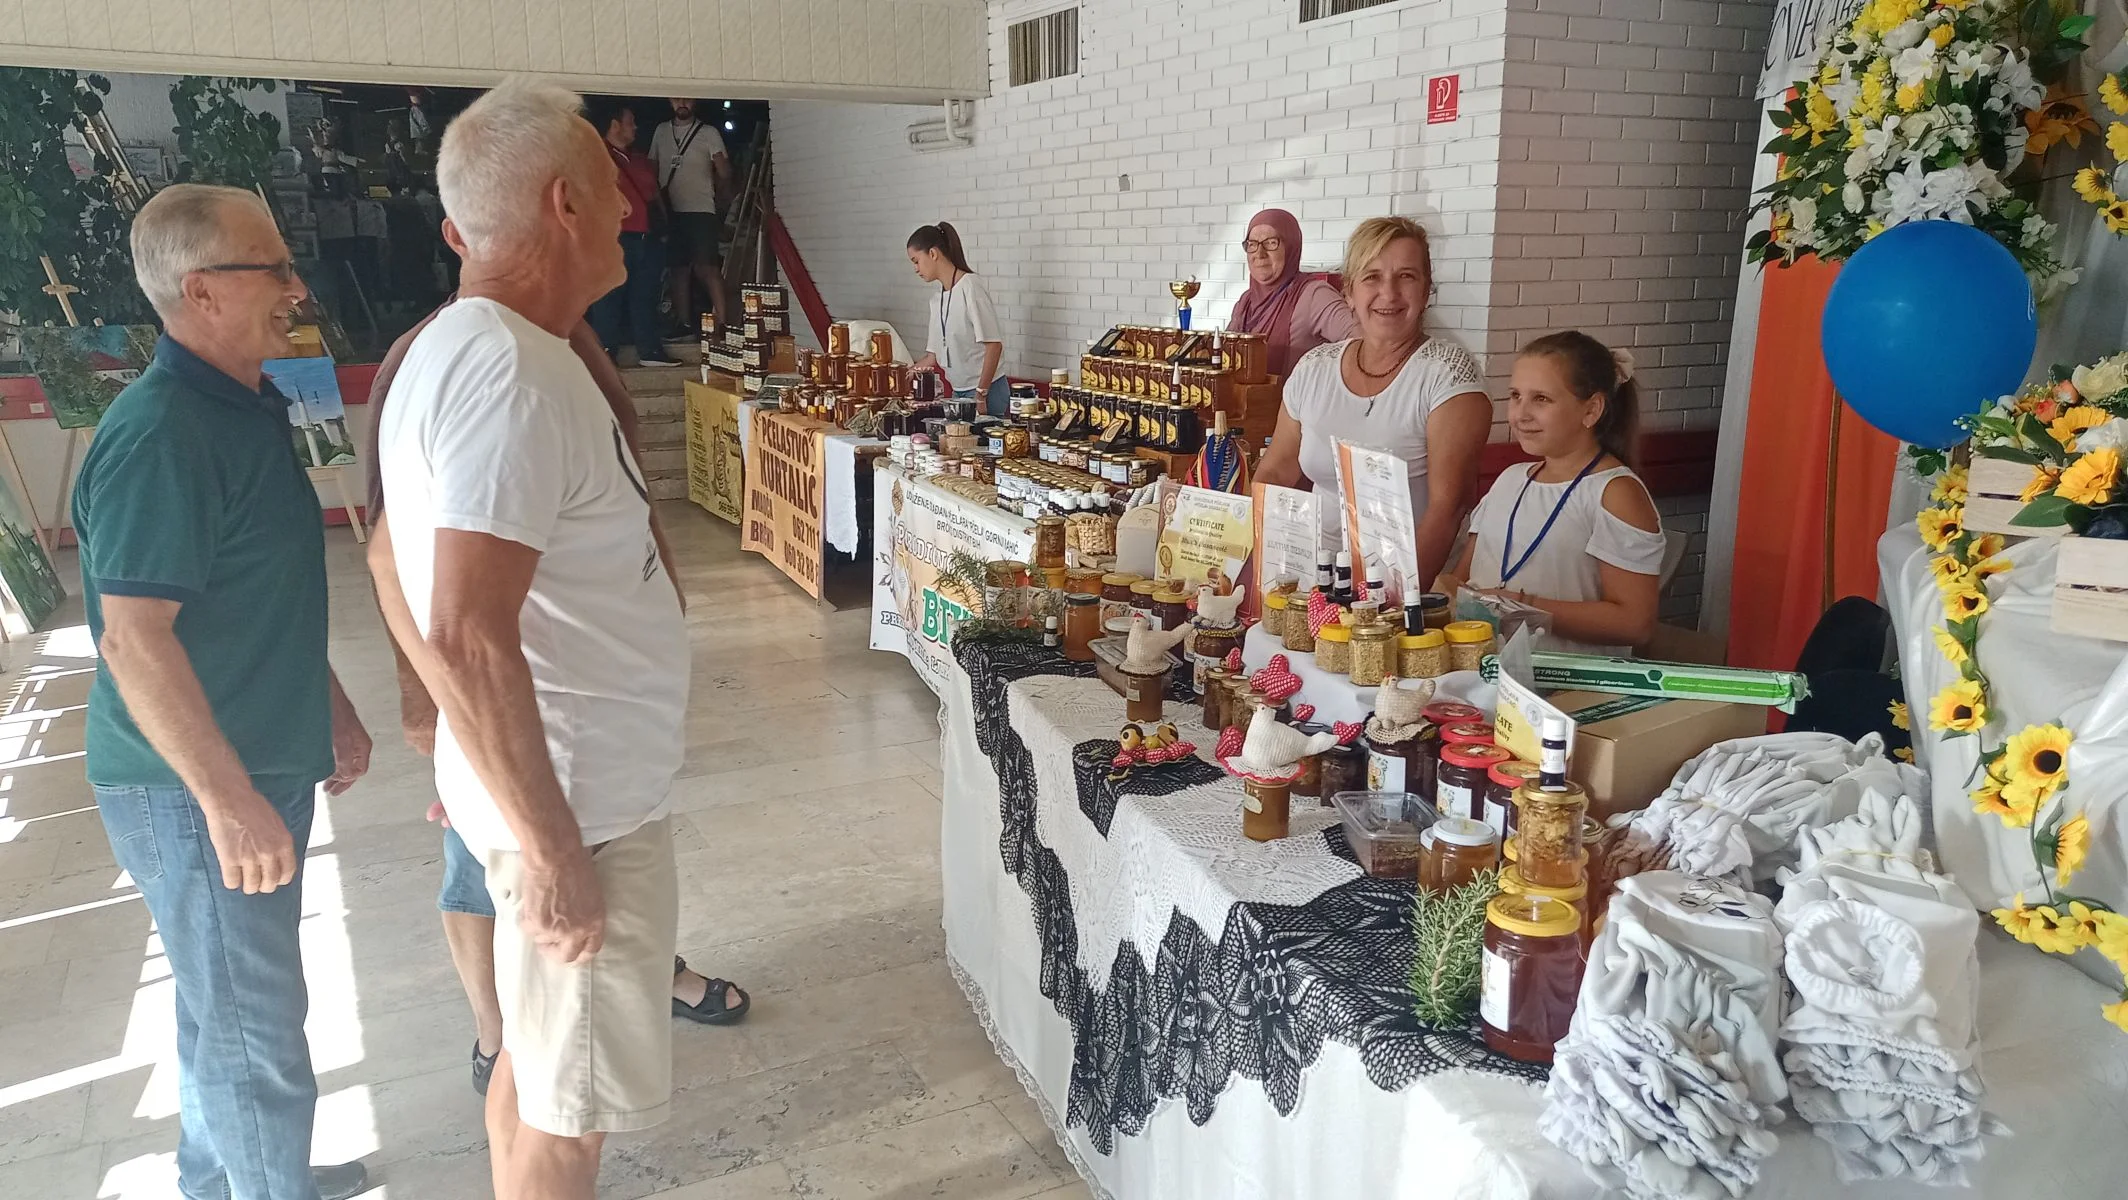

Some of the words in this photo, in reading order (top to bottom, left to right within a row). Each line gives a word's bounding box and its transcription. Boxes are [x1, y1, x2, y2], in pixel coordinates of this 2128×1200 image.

[762, 413, 810, 468] PČELASTVO
[759, 446, 818, 520] KURTALIĆ
[1535, 668, 1571, 677] STRONG
[1496, 712, 1513, 732] CATE
